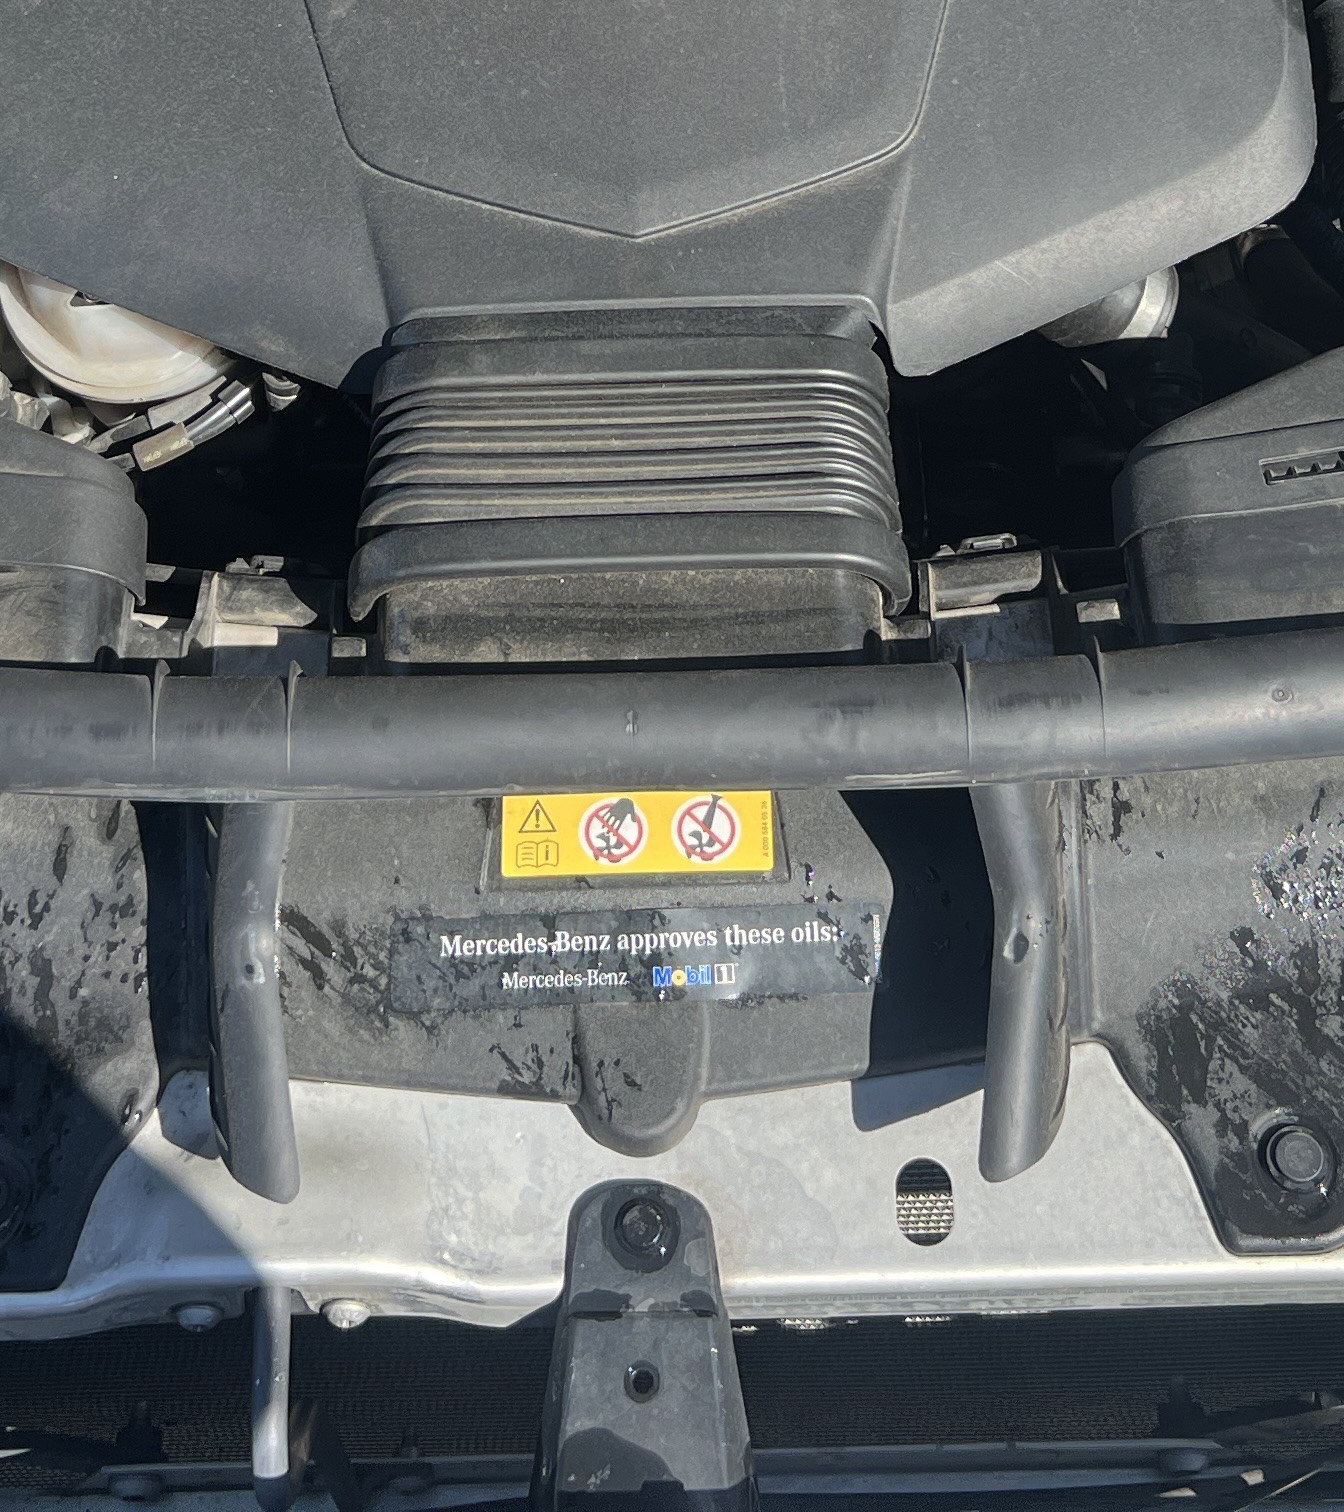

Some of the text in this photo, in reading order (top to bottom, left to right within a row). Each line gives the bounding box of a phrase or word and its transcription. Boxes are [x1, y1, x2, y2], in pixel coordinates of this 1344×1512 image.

[439, 920, 839, 958] Mercedes-Benz approves these oils:
[502, 968, 628, 990] Mercedes-Benz
[653, 964, 712, 987] Mobil
